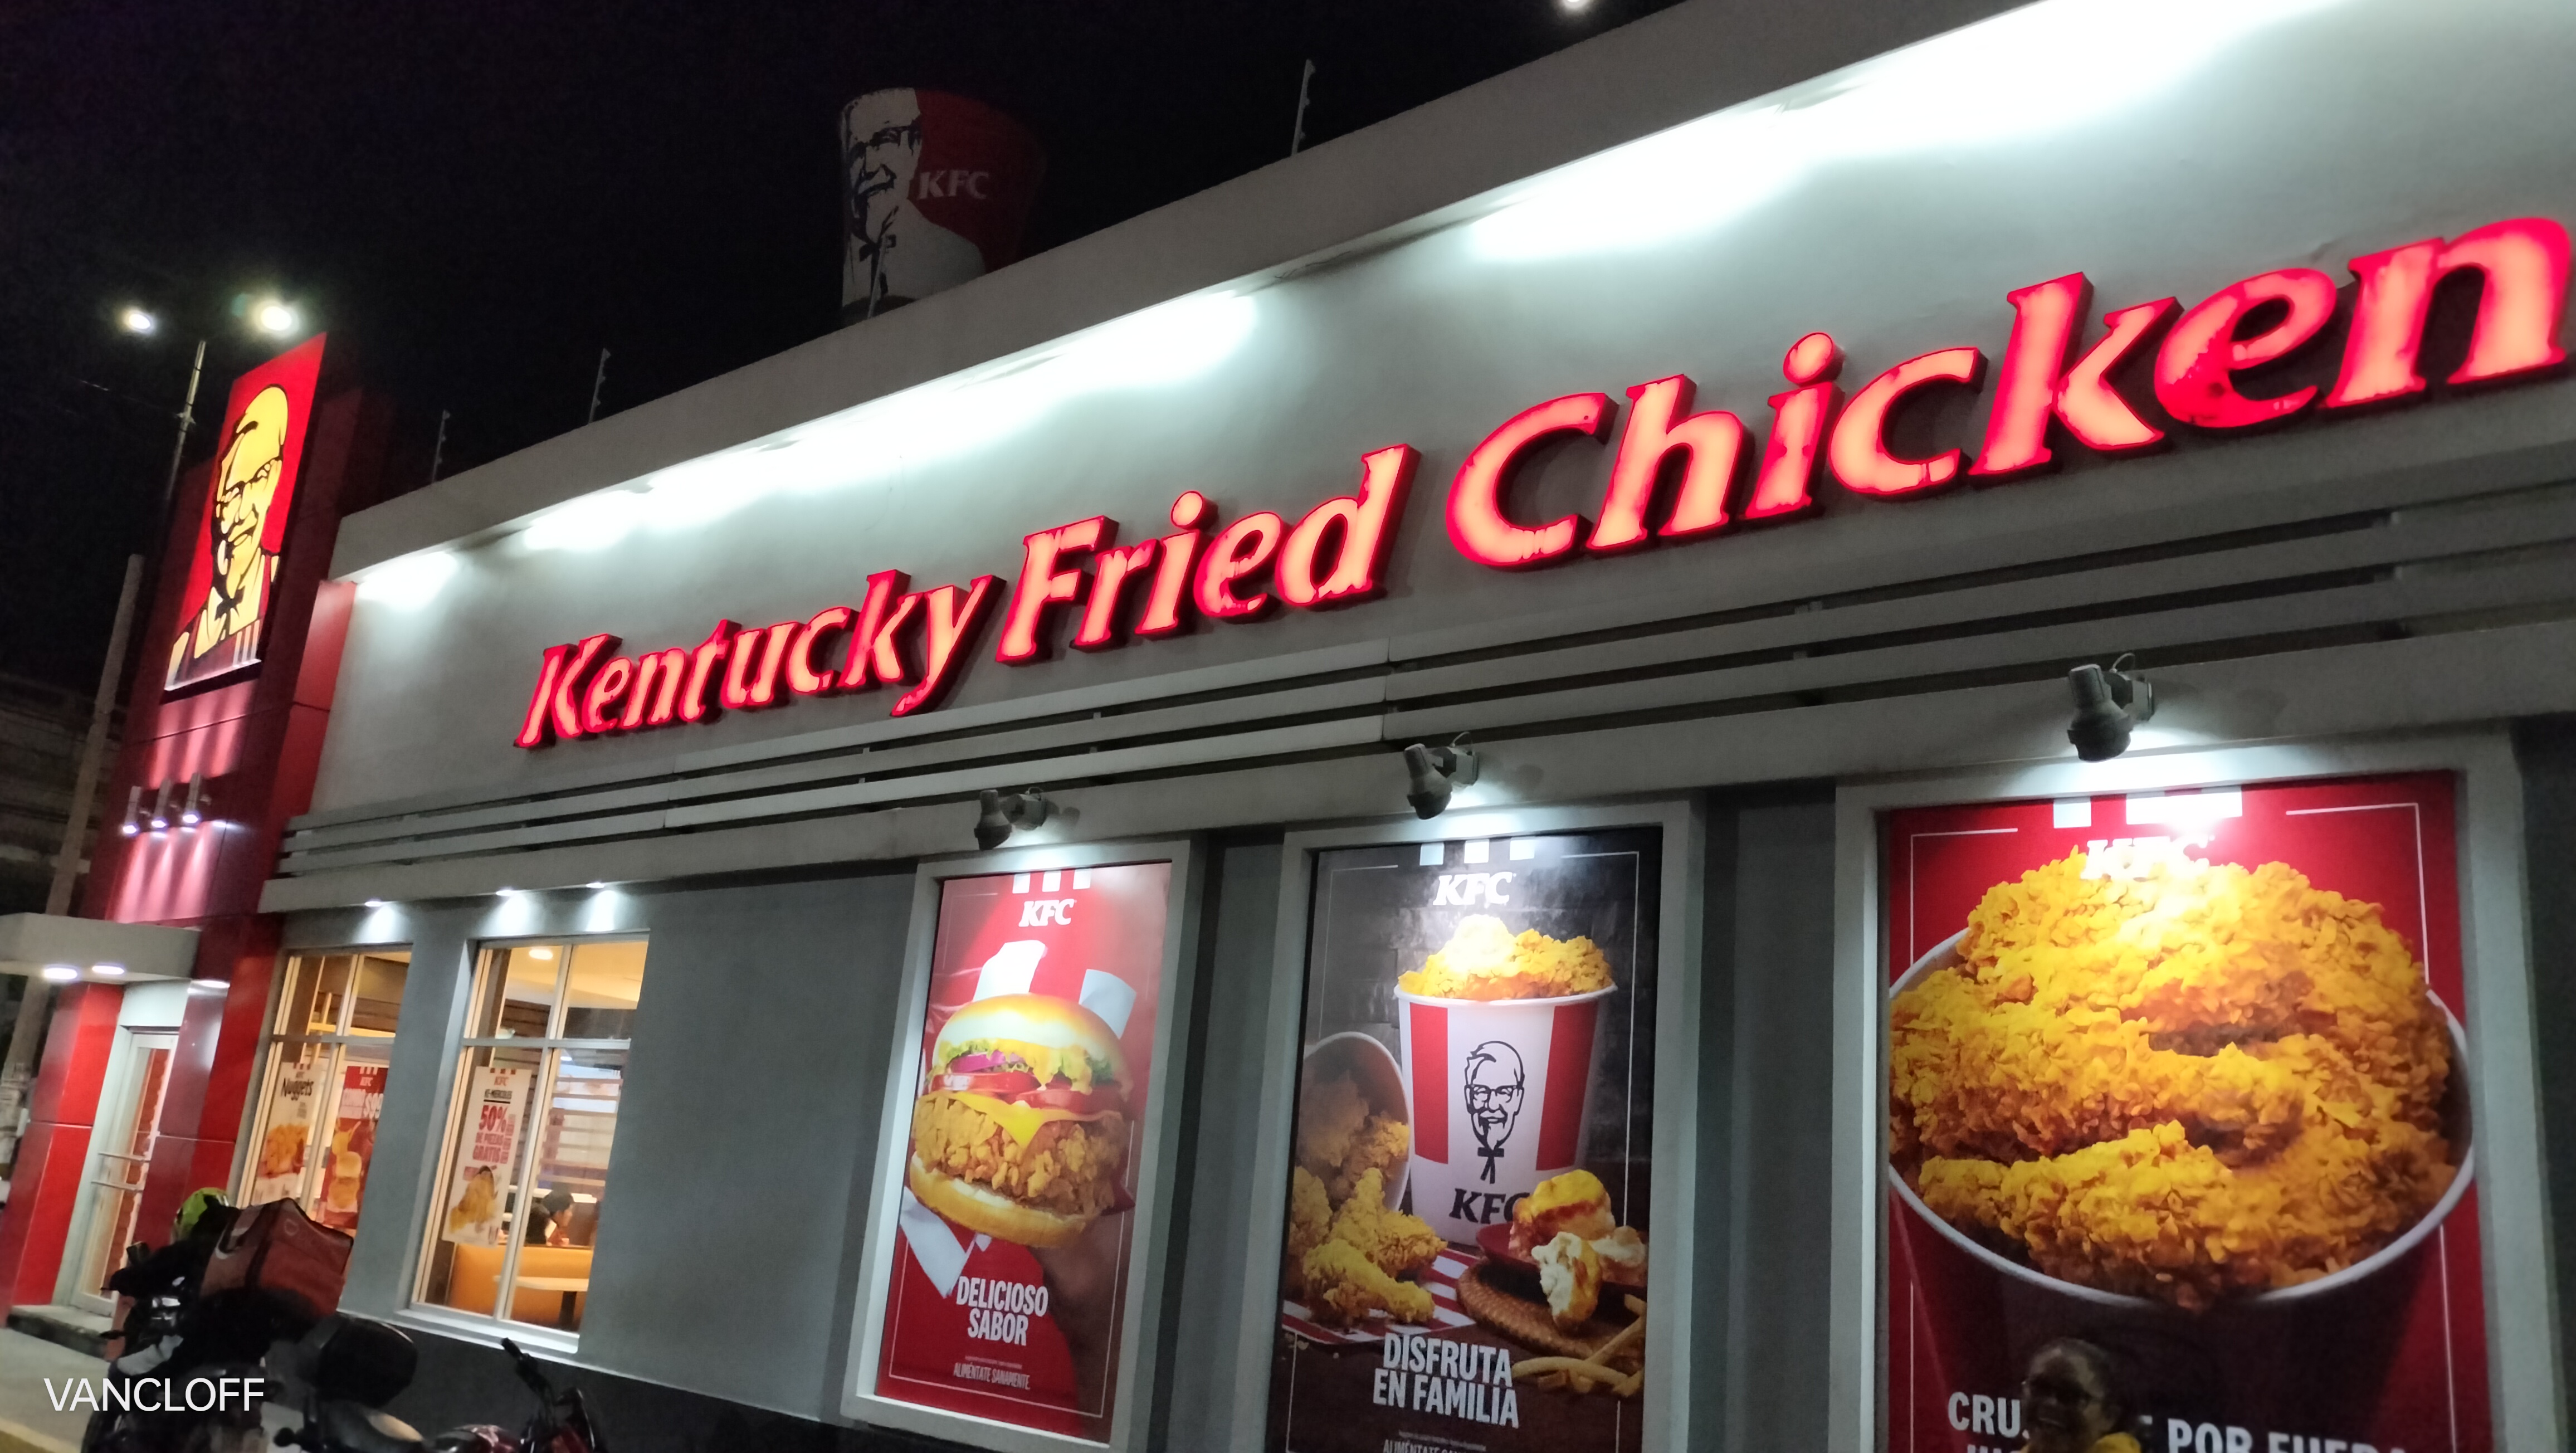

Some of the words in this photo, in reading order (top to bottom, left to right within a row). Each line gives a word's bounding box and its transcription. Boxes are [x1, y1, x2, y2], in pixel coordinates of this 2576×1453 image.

[917, 169, 989, 199] KFC
[515, 569, 1005, 747] Kentucky
[997, 444, 1420, 664] Fried
[1446, 217, 2570, 568] Chicken
[1433, 871, 1513, 906] KFC
[1018, 899, 1075, 927] KFC
[281, 1077, 315, 1101] Nuggets
[479, 1104, 508, 1133] 50%
[956, 1276, 1048, 1317] DELICIOSO
[967, 1308, 1028, 1346] SABOR
[1383, 1332, 1513, 1388] DISFRUTA
[1373, 1368, 1406, 1408] EN
[1413, 1374, 1519, 1428] FAMILIA
